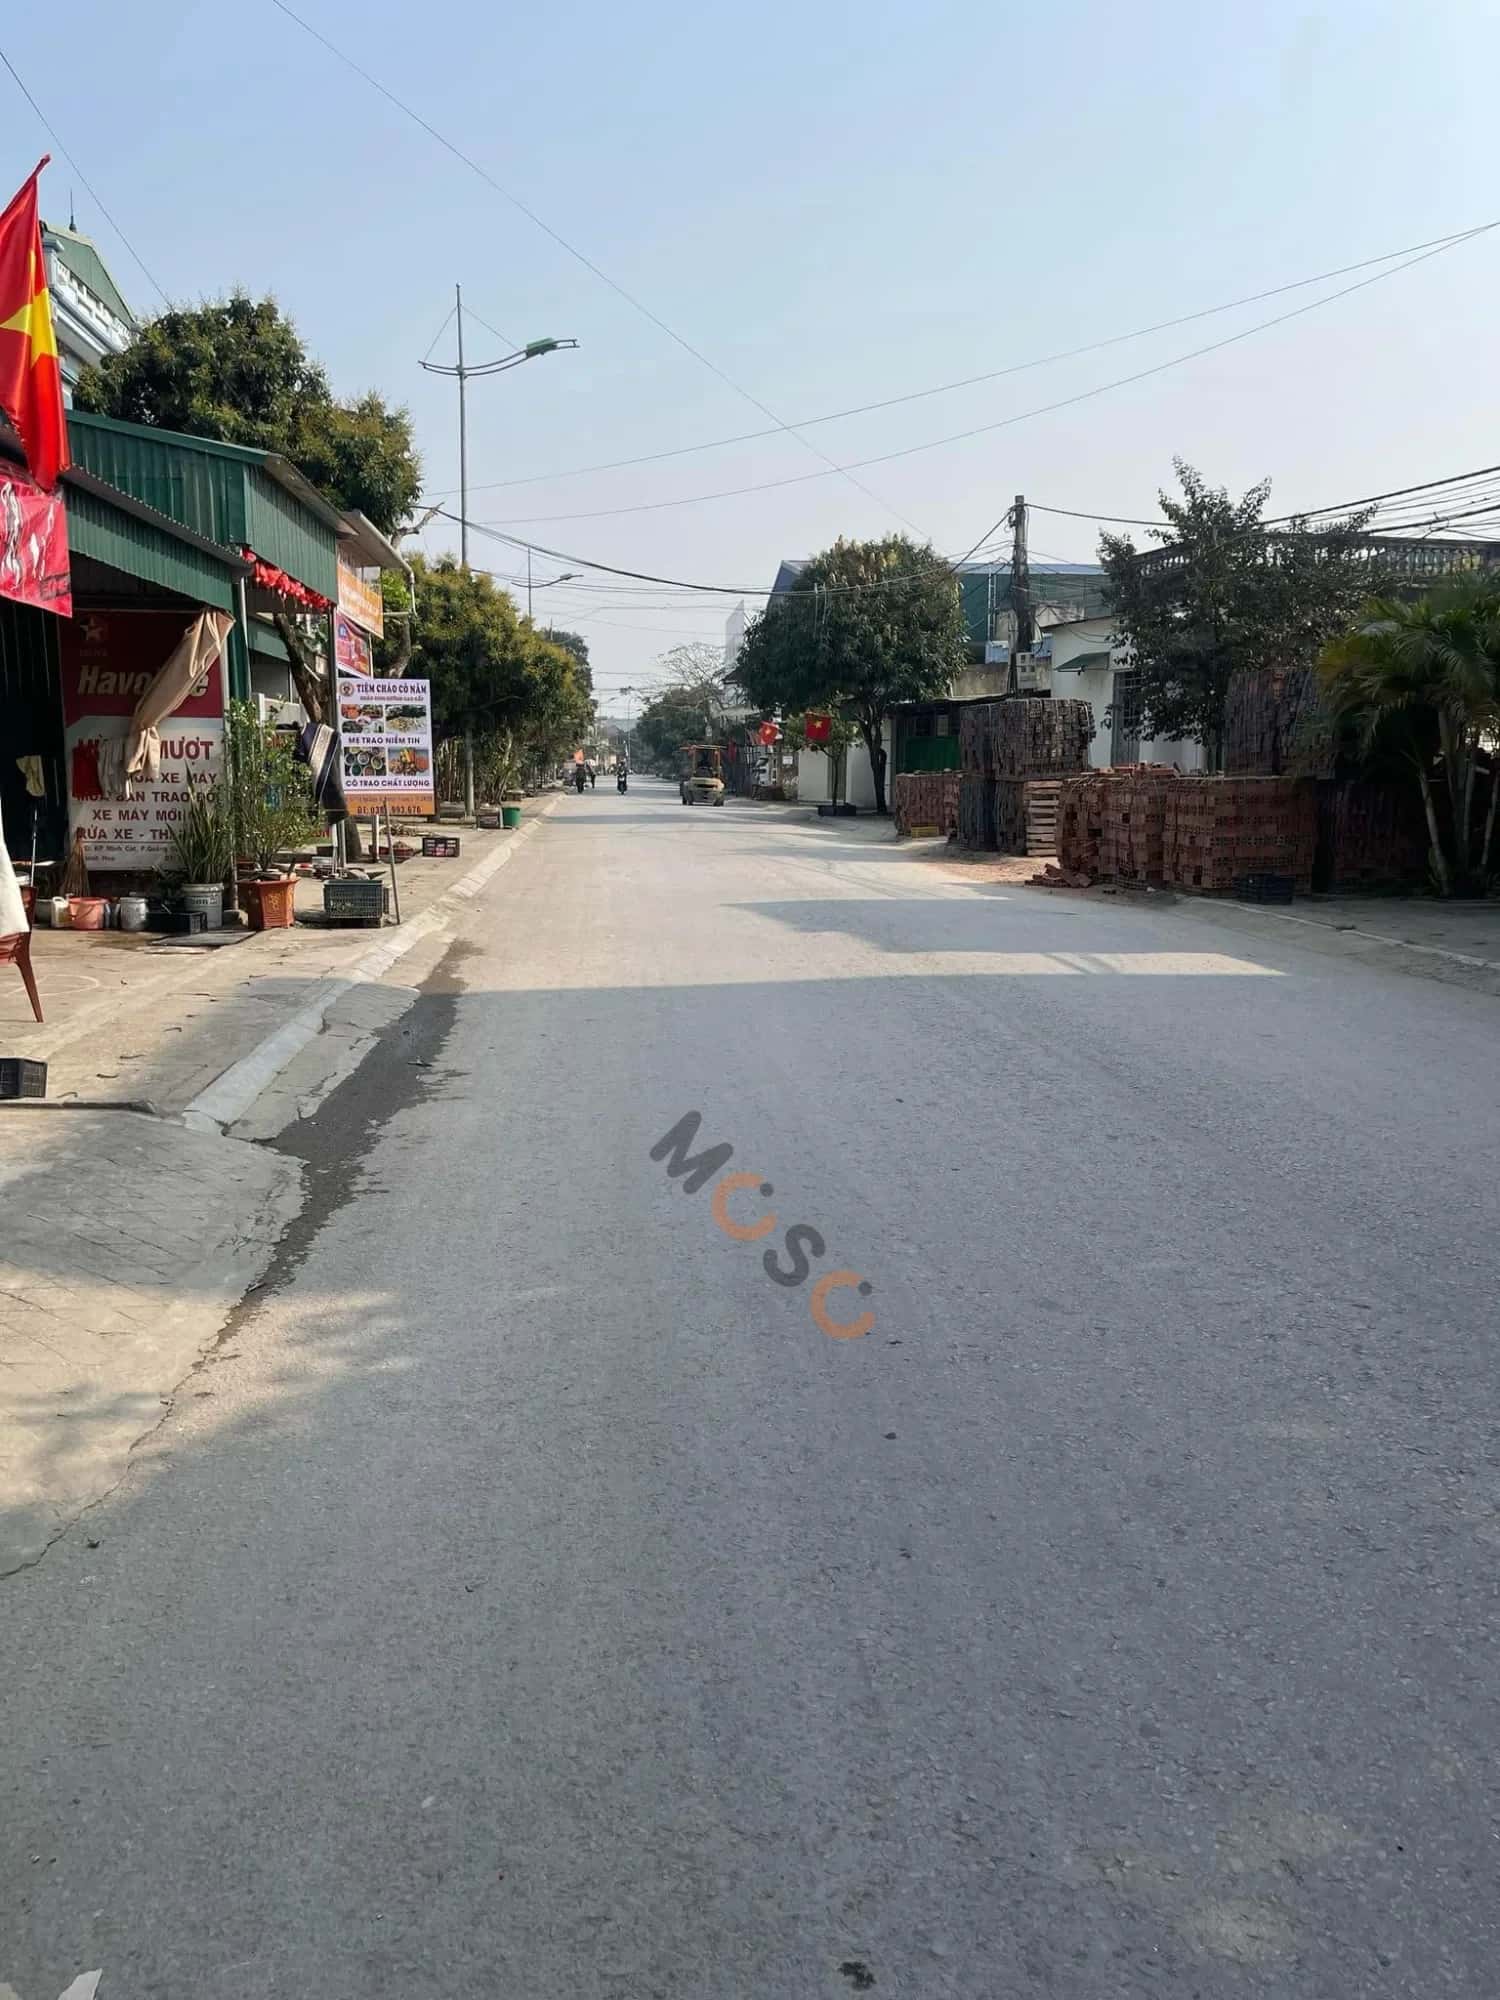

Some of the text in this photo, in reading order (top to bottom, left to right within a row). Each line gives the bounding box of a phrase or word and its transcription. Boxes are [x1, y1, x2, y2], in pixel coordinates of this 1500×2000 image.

[78, 664, 209, 697] Havoe
[362, 737, 384, 745] TRAO
[161, 772, 180, 783] XE
[345, 779, 358, 787] CÔ
[152, 791, 190, 803] TRAO
[92, 809, 112, 821] XE
[118, 806, 149, 821] MÁY
[155, 808, 182, 821] MỚI
[75, 823, 107, 840] RỬA
[114, 829, 133, 840] XE
